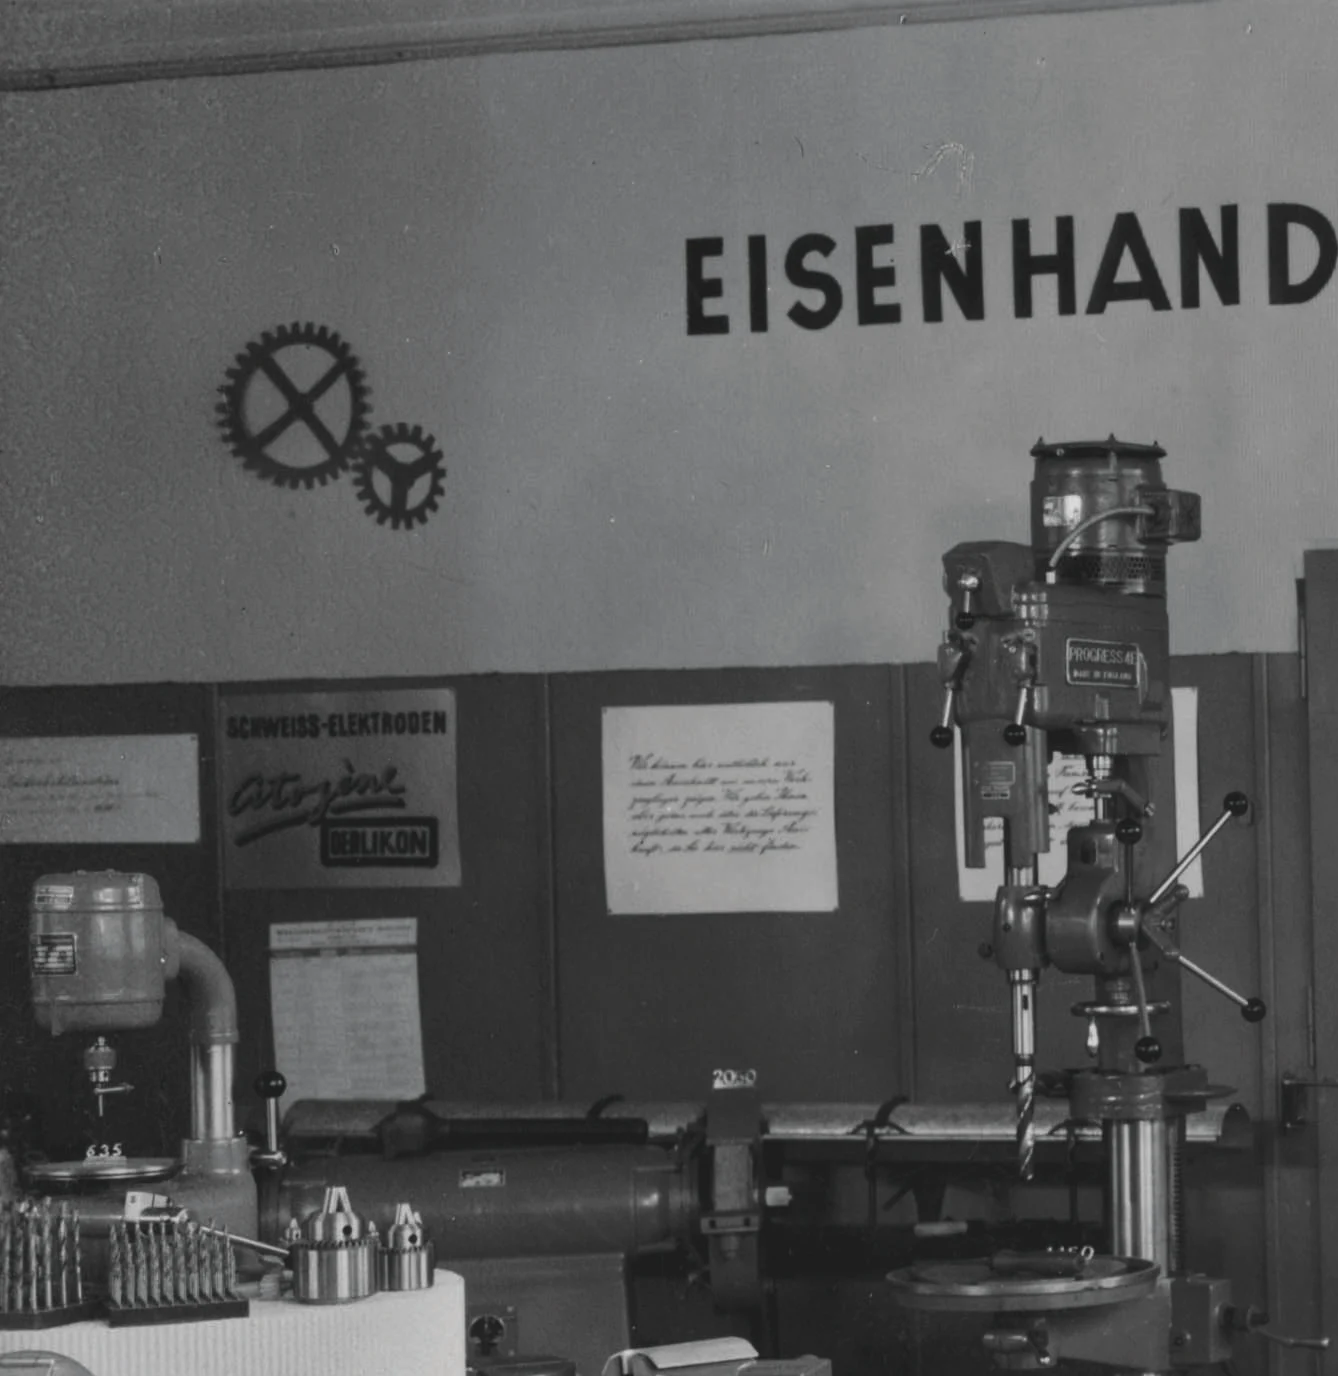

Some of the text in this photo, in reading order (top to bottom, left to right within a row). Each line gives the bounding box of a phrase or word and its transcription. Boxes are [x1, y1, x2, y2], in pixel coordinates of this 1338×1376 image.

[1069, 646, 1124, 663] PROGRESS
[226, 711, 447, 739] SCHWEISS-ELEKTRODEN
[330, 828, 428, 856] OERLIKON
[86, 1143, 122, 1157] 635
